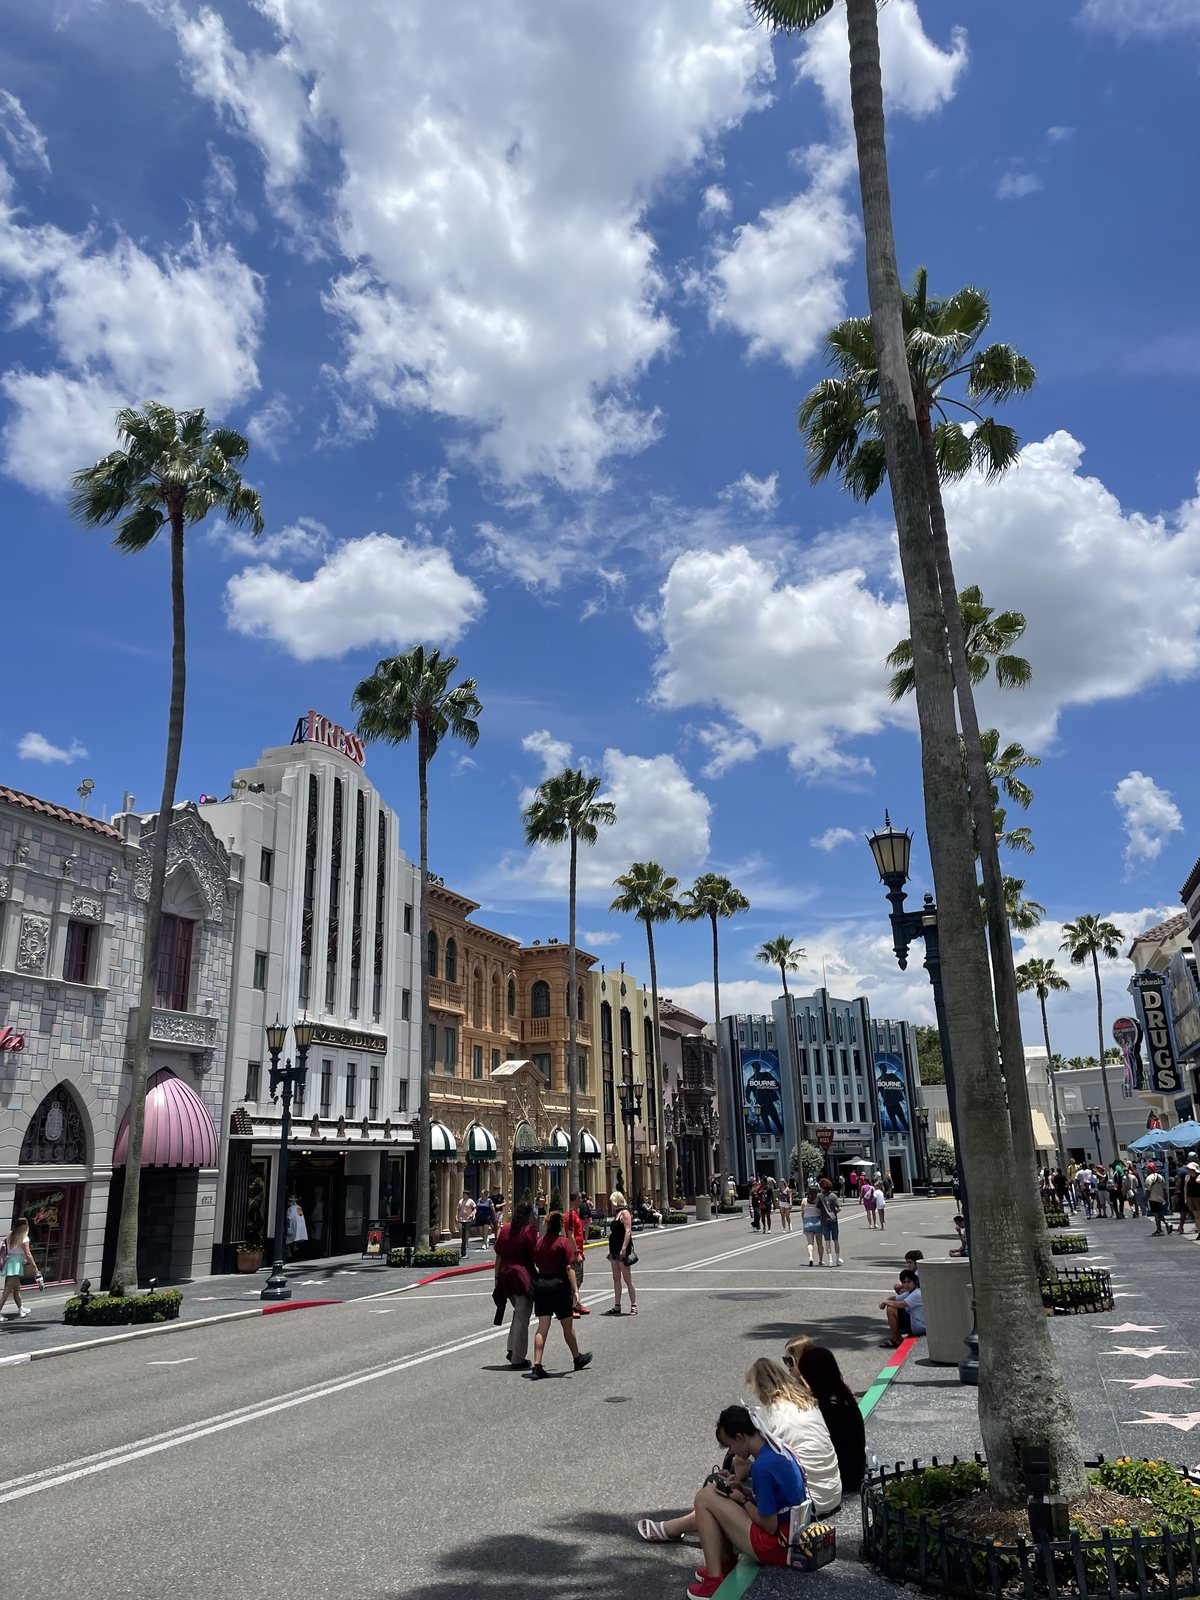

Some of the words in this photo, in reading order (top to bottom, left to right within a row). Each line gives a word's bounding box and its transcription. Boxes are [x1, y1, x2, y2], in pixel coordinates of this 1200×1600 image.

[308, 709, 366, 767] KRESS
[312, 1029, 336, 1042] IVE
[354, 1036, 384, 1049] DIME
[1142, 991, 1176, 1089] DRUGS
